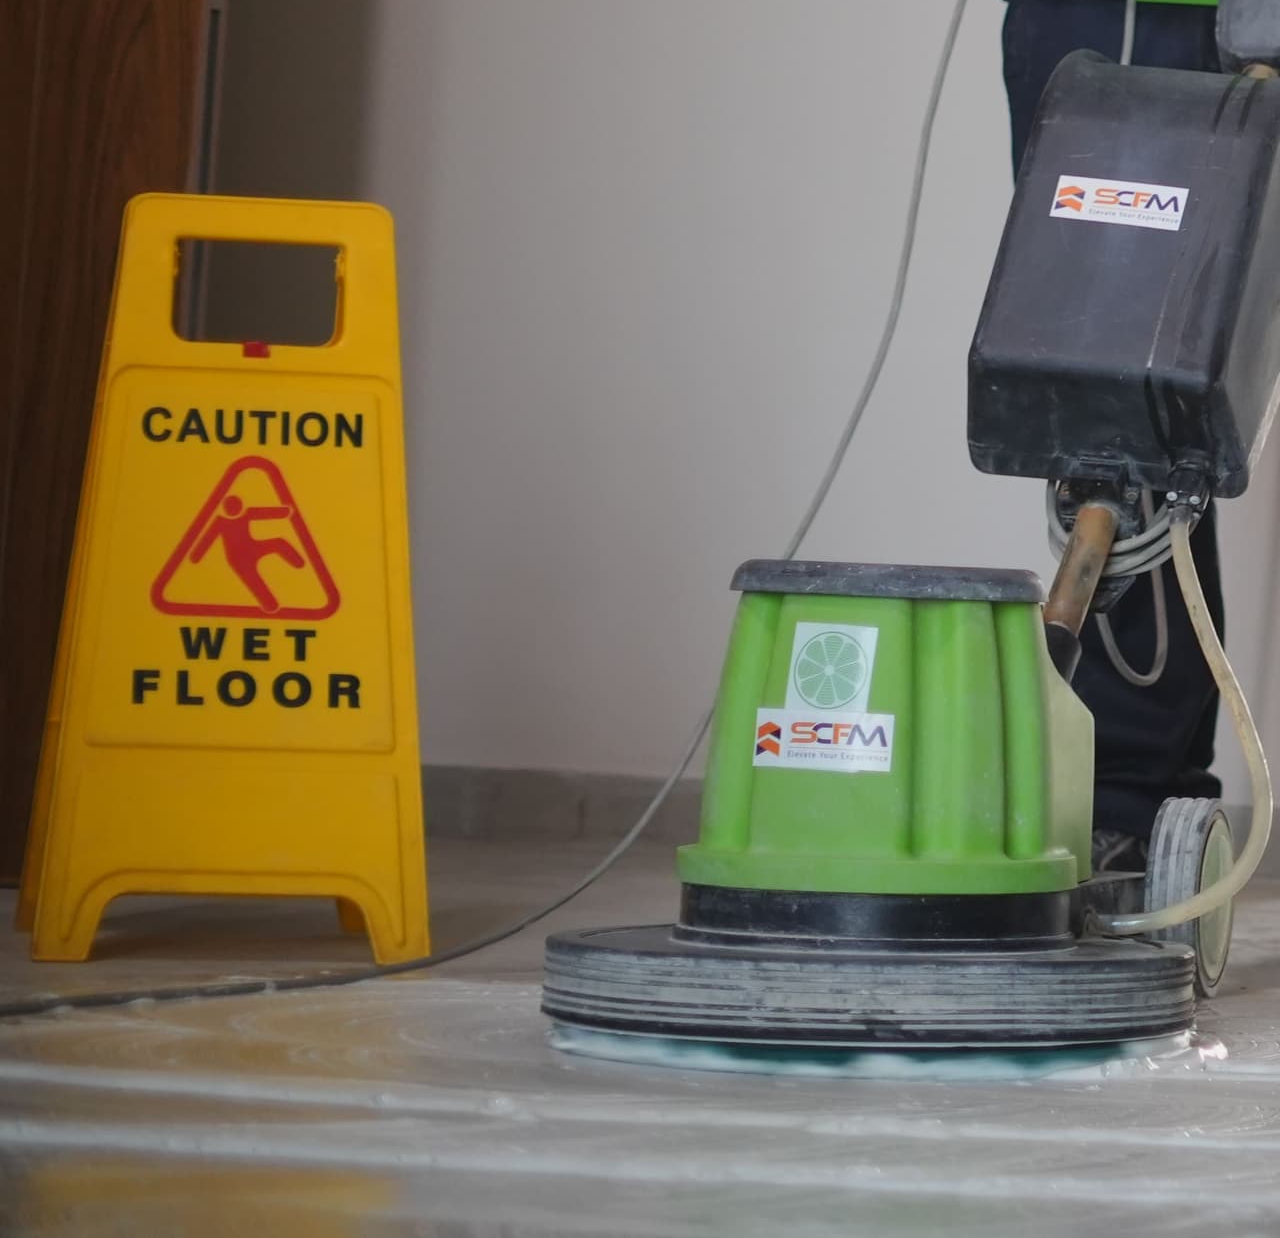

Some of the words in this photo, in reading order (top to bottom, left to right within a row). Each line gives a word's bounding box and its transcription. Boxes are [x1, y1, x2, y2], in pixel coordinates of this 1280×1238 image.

[1094, 188, 1179, 212] SCFM
[141, 407, 364, 448] CAUTION
[179, 627, 317, 662] WET
[131, 669, 362, 709] FLOOR
[790, 721, 887, 747] SCFM
